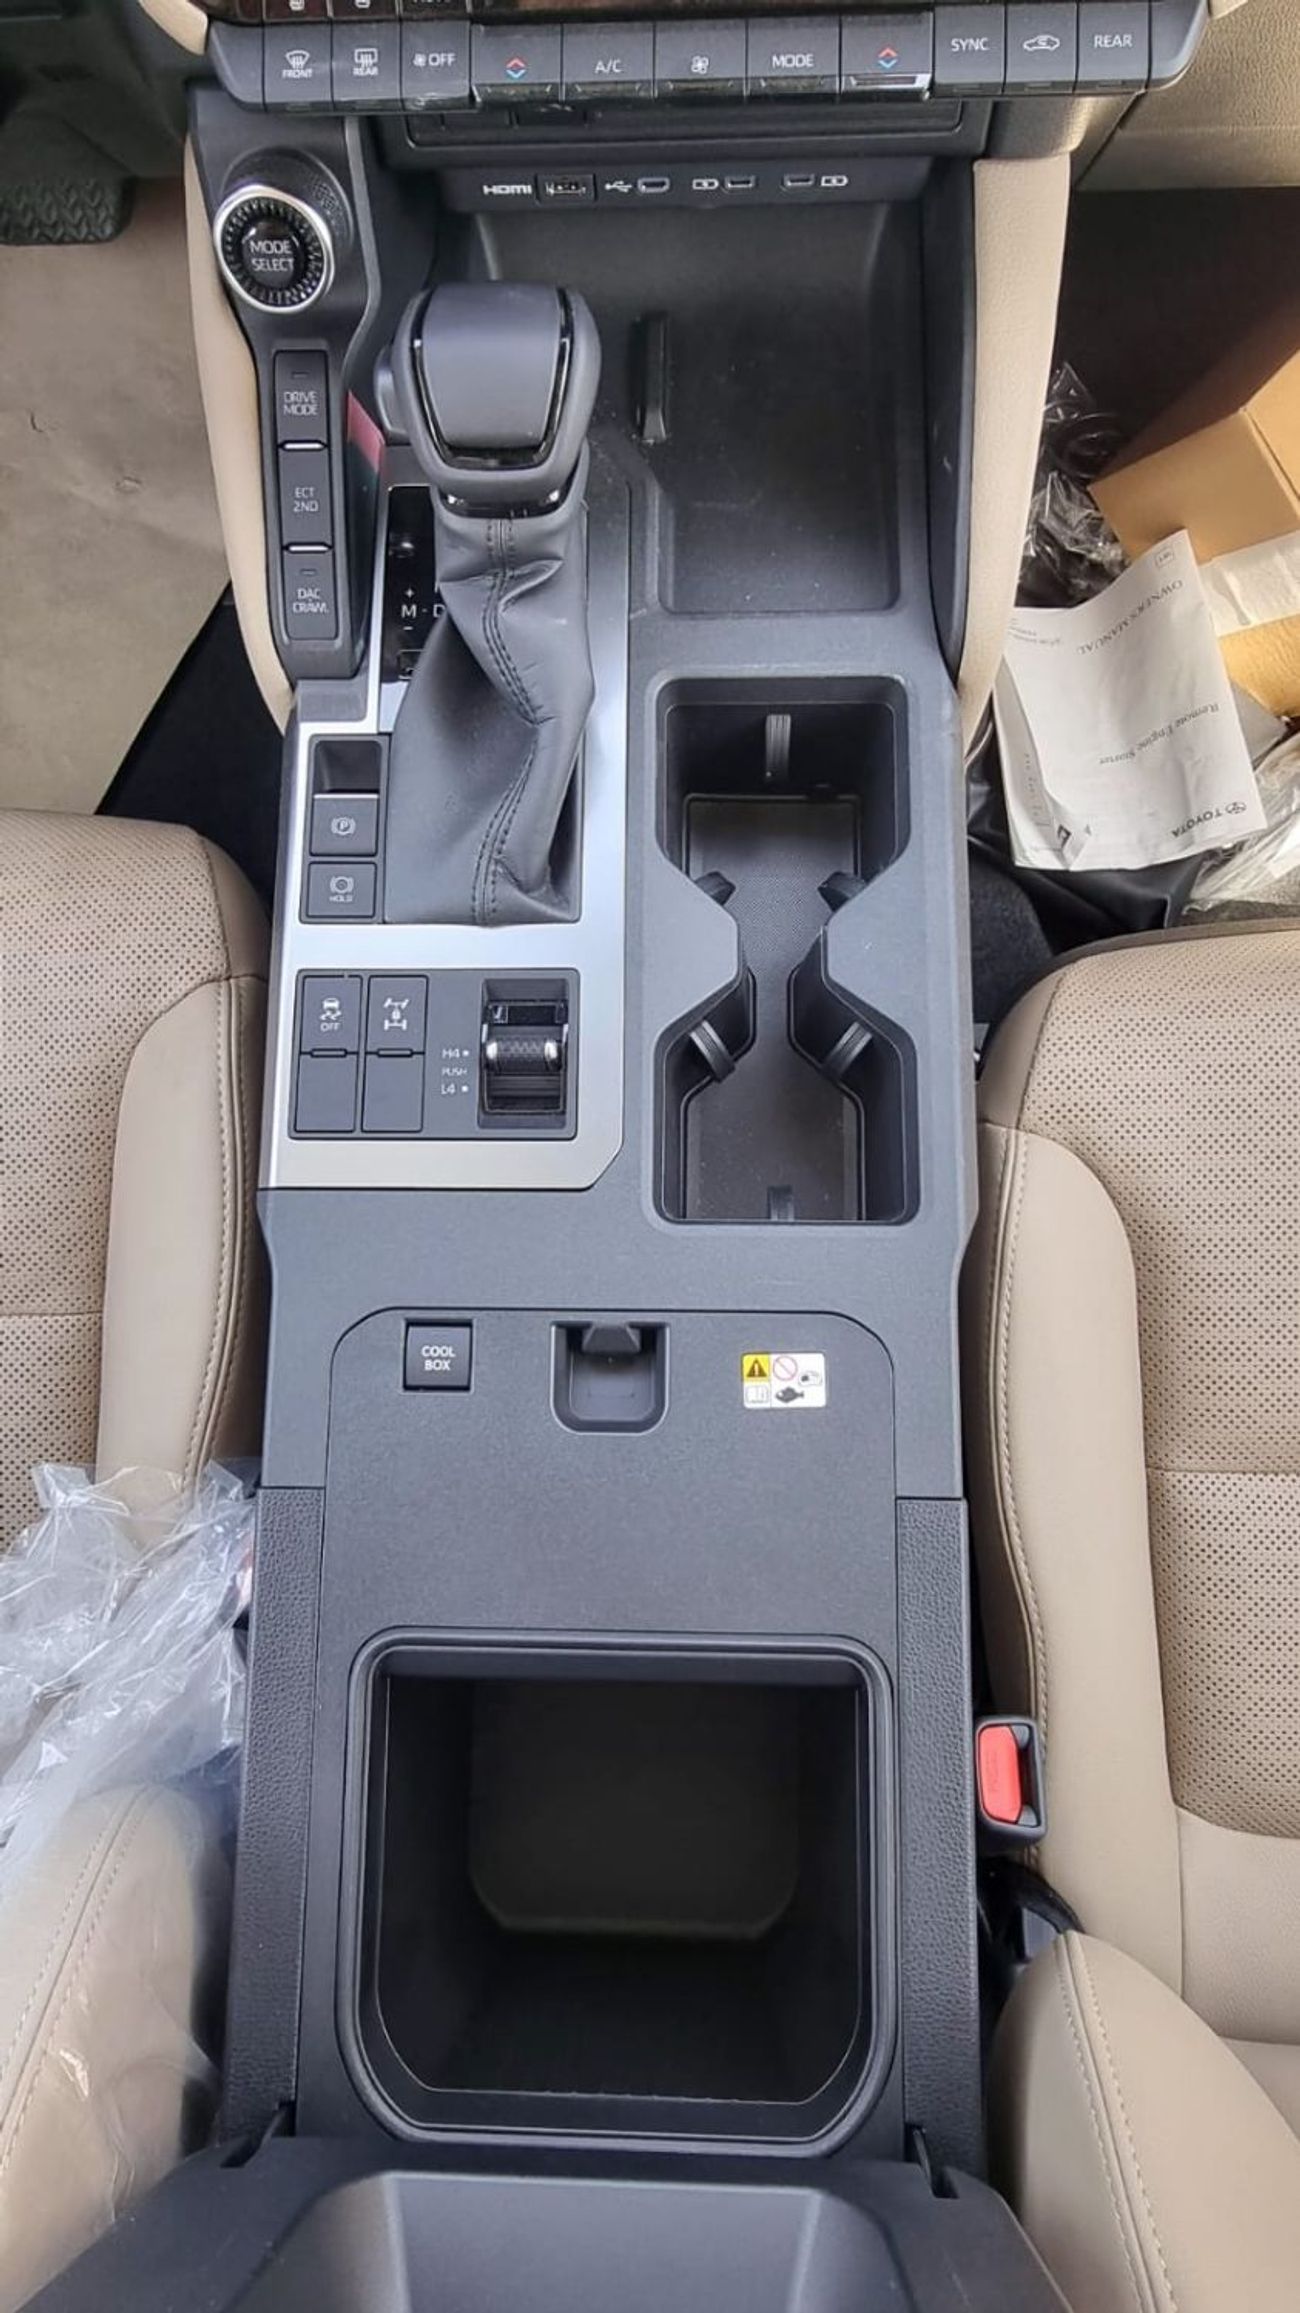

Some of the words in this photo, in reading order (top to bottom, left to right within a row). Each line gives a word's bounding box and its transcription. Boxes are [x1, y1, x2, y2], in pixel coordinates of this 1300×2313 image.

[950, 36, 989, 53] SYNC
[1093, 33, 1133, 49] REAR
[428, 52, 456, 66] OFF
[772, 53, 814, 69] MODE
[353, 67, 379, 77] REAR
[594, 59, 622, 74] A/C
[282, 68, 313, 79] FRONT
[482, 184, 532, 195] HDMI
[250, 240, 293, 255] MODE
[251, 257, 295, 272] SELECT
[283, 391, 318, 403] DRIVE
[283, 404, 319, 416] MODE
[295, 487, 315, 499] ECT
[293, 500, 319, 512] 2ND
[297, 587, 321, 600] DAC
[1175, 703, 1220, 728] Remote
[1171, 807, 1223, 838] TOYOTA
[320, 1020, 342, 1033] OFF
[442, 1048, 460, 1059] H4
[441, 1066, 468, 1077] PUSH
[440, 1083, 456, 1095] L4
[421, 1345, 456, 1358] COOL
[424, 1359, 452, 1371] BOX
